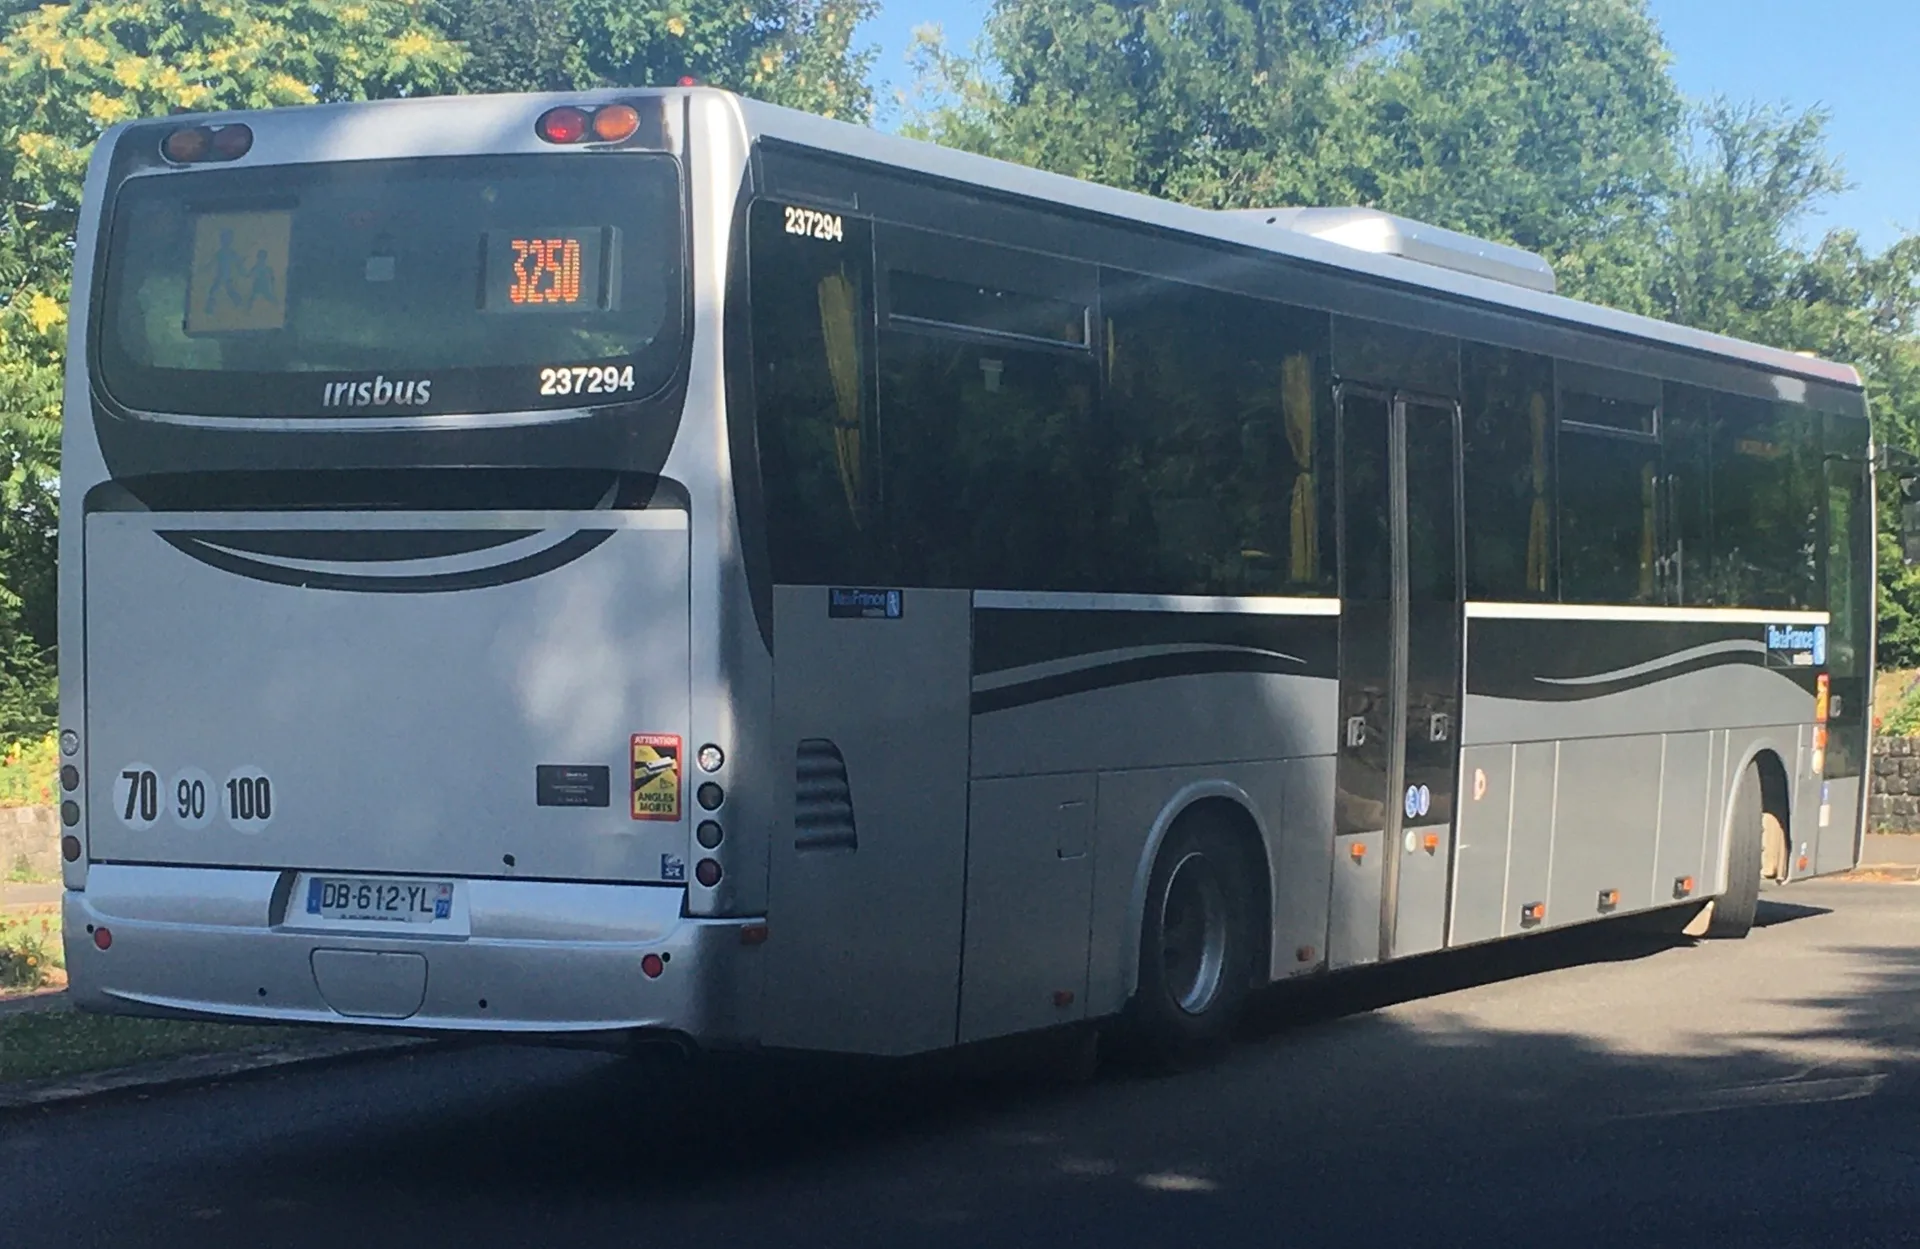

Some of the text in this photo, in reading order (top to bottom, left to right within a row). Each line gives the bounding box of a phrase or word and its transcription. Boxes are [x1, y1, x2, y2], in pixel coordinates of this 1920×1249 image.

[785, 206, 843, 242] 237294
[511, 239, 580, 303] 3250
[323, 375, 431, 407] irisbus
[540, 366, 635, 395] 237294
[634, 735, 679, 745] ATTENTION
[122, 770, 158, 821] 70
[177, 779, 205, 819] 90
[226, 776, 271, 820] 100
[637, 791, 674, 803] ANGLES
[639, 801, 673, 813] MORTS
